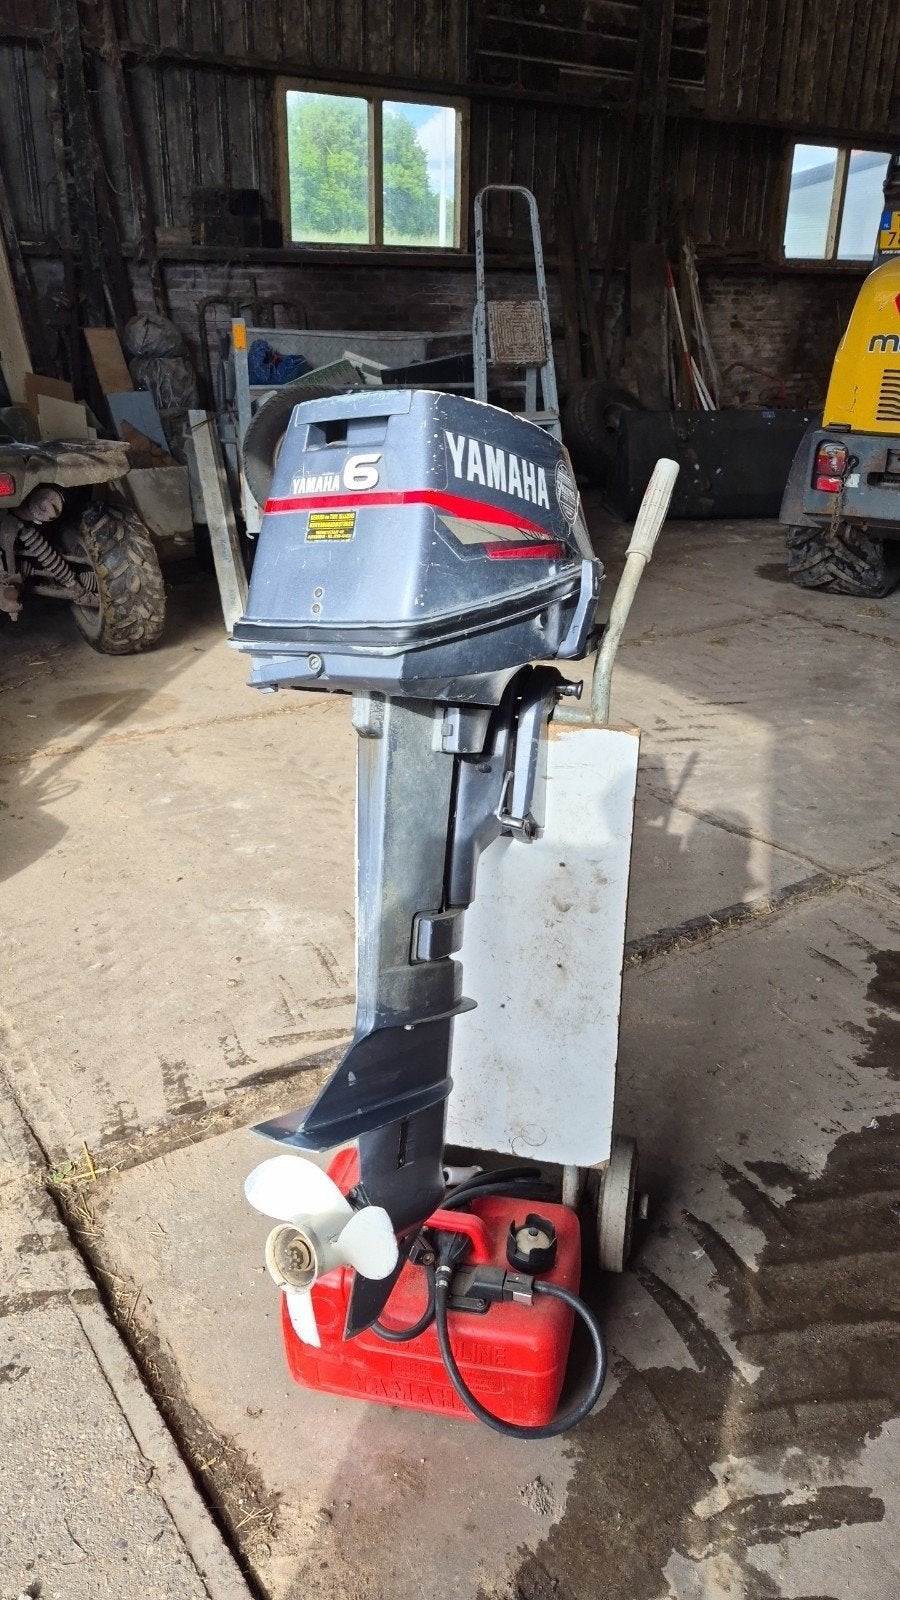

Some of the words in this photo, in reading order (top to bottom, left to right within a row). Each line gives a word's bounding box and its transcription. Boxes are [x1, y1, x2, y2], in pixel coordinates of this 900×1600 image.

[887, 231, 900, 247] 7
[868, 334, 900, 352] m
[292, 474, 340, 495] YAMAHA
[343, 453, 382, 491] 6
[445, 430, 550, 510] YAMAHA
[398, 1336, 507, 1367] ASLINE
